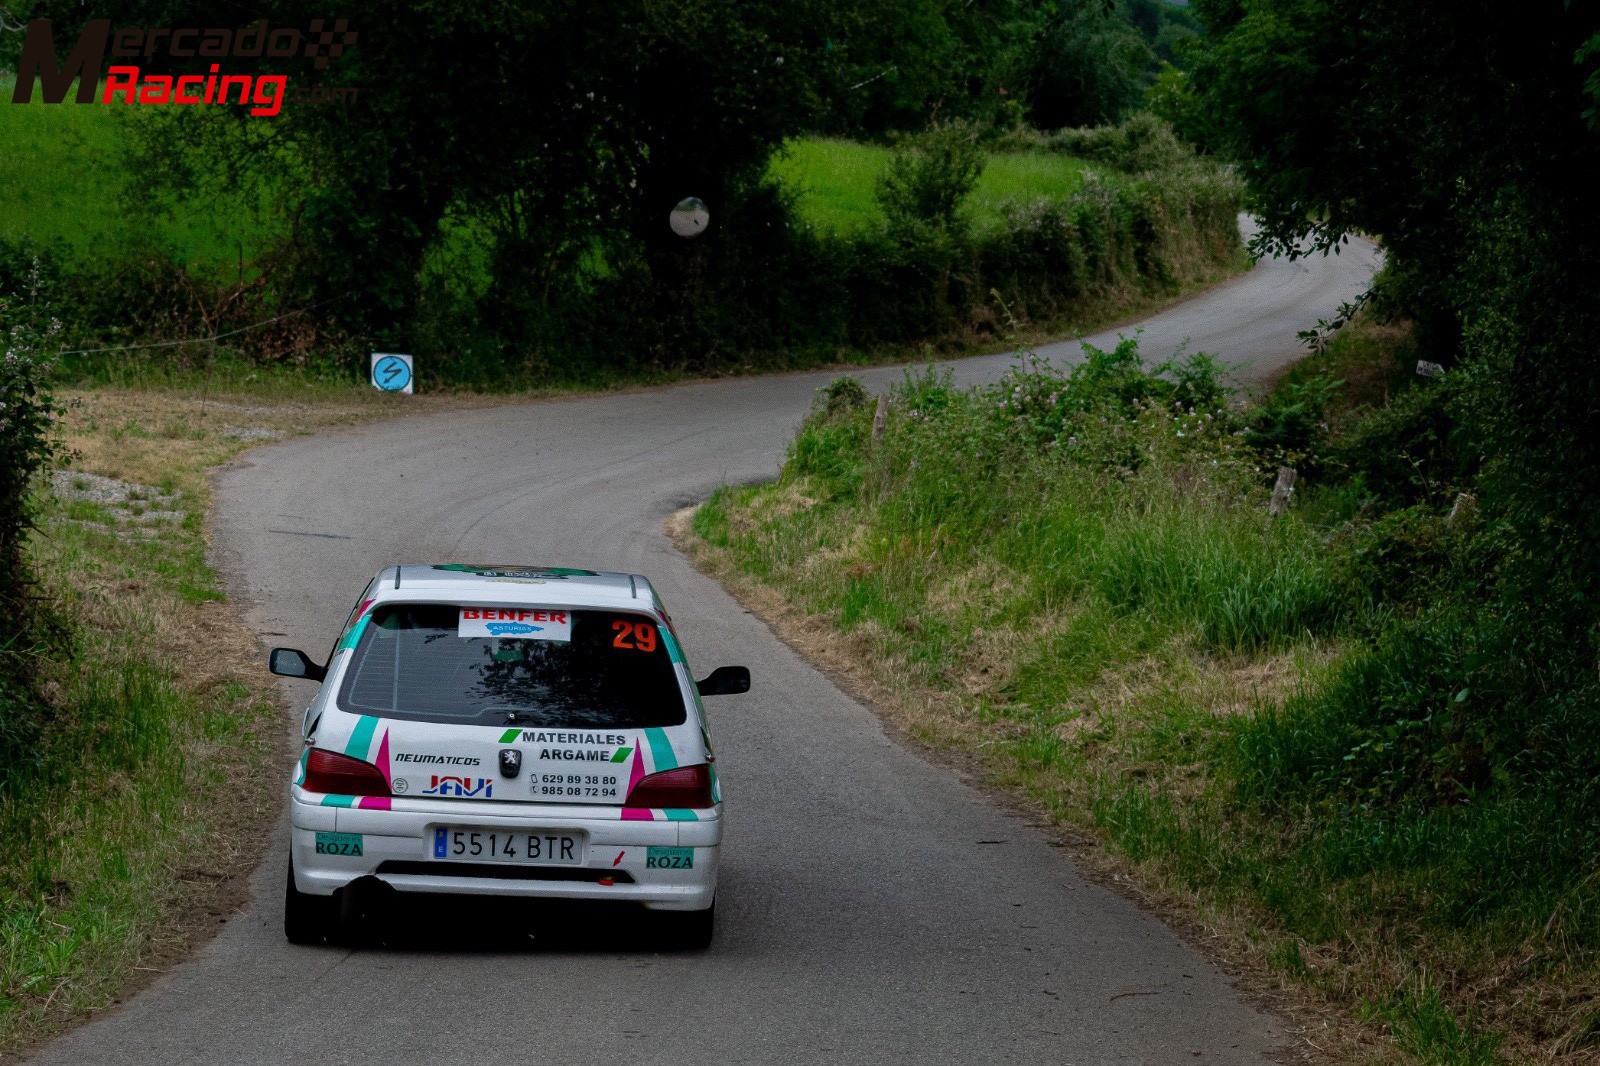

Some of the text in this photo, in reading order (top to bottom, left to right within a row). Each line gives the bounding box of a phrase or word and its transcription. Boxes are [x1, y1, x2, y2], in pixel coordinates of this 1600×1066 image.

[463, 609, 567, 624] BENFER
[611, 620, 656, 652] 29
[522, 732, 626, 745] MATERIALES
[395, 753, 480, 766] NEUMATICOS
[540, 749, 609, 762] ARGAME
[422, 775, 492, 798] JAVI
[542, 775, 616, 785] 629 89 38 80
[542, 786, 616, 796] 985 08 72 94
[316, 842, 363, 856] ROZA
[453, 832, 573, 860] 5514 BTR
[646, 857, 693, 869] ROZA
